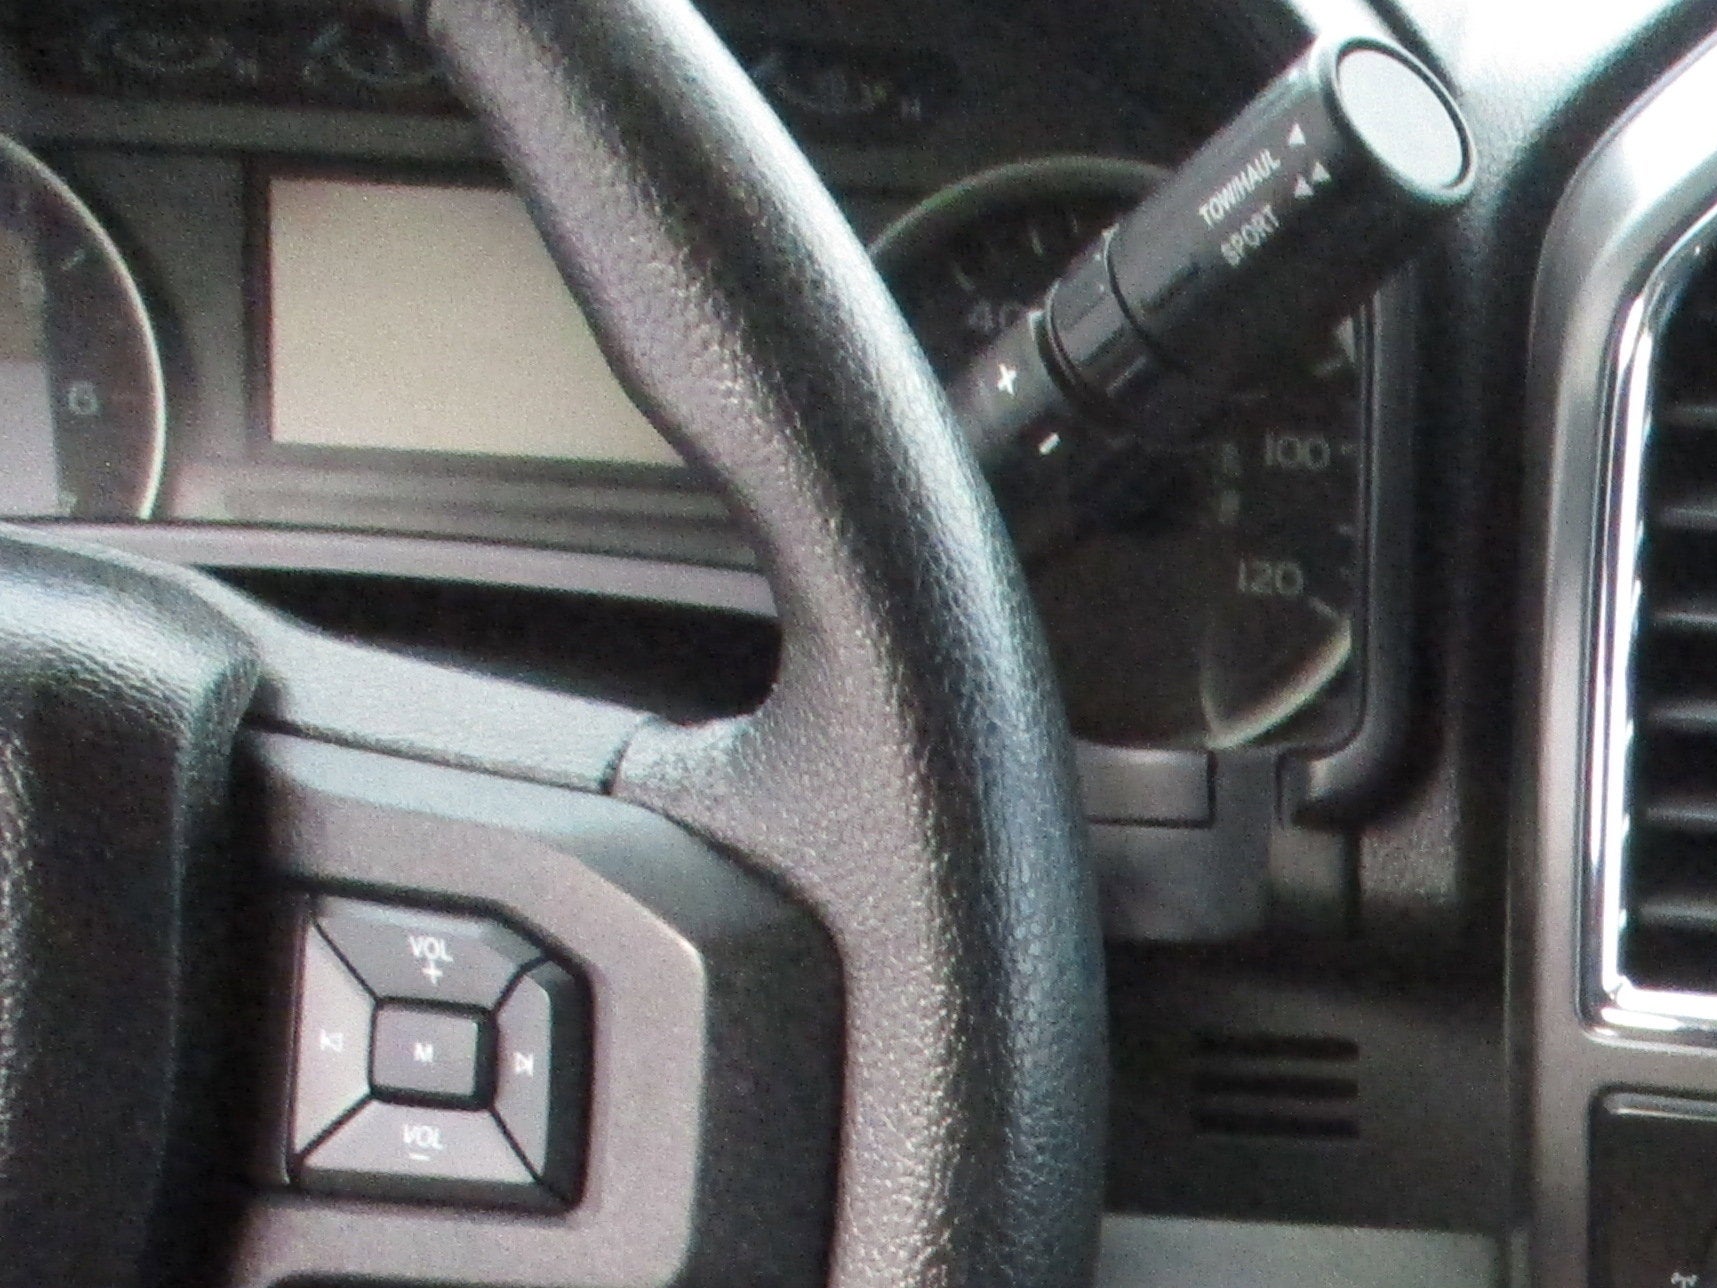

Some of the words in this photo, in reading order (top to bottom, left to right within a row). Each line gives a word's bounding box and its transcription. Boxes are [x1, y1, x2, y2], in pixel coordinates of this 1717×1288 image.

[1220, 203, 1280, 268] SPORT
[67, 379, 99, 417] 6
[1264, 435, 1331, 470] 100
[1237, 561, 1304, 595] 120
[408, 935, 453, 963] VOL
[414, 1042, 434, 1063] M
[403, 1124, 444, 1150] VOL
